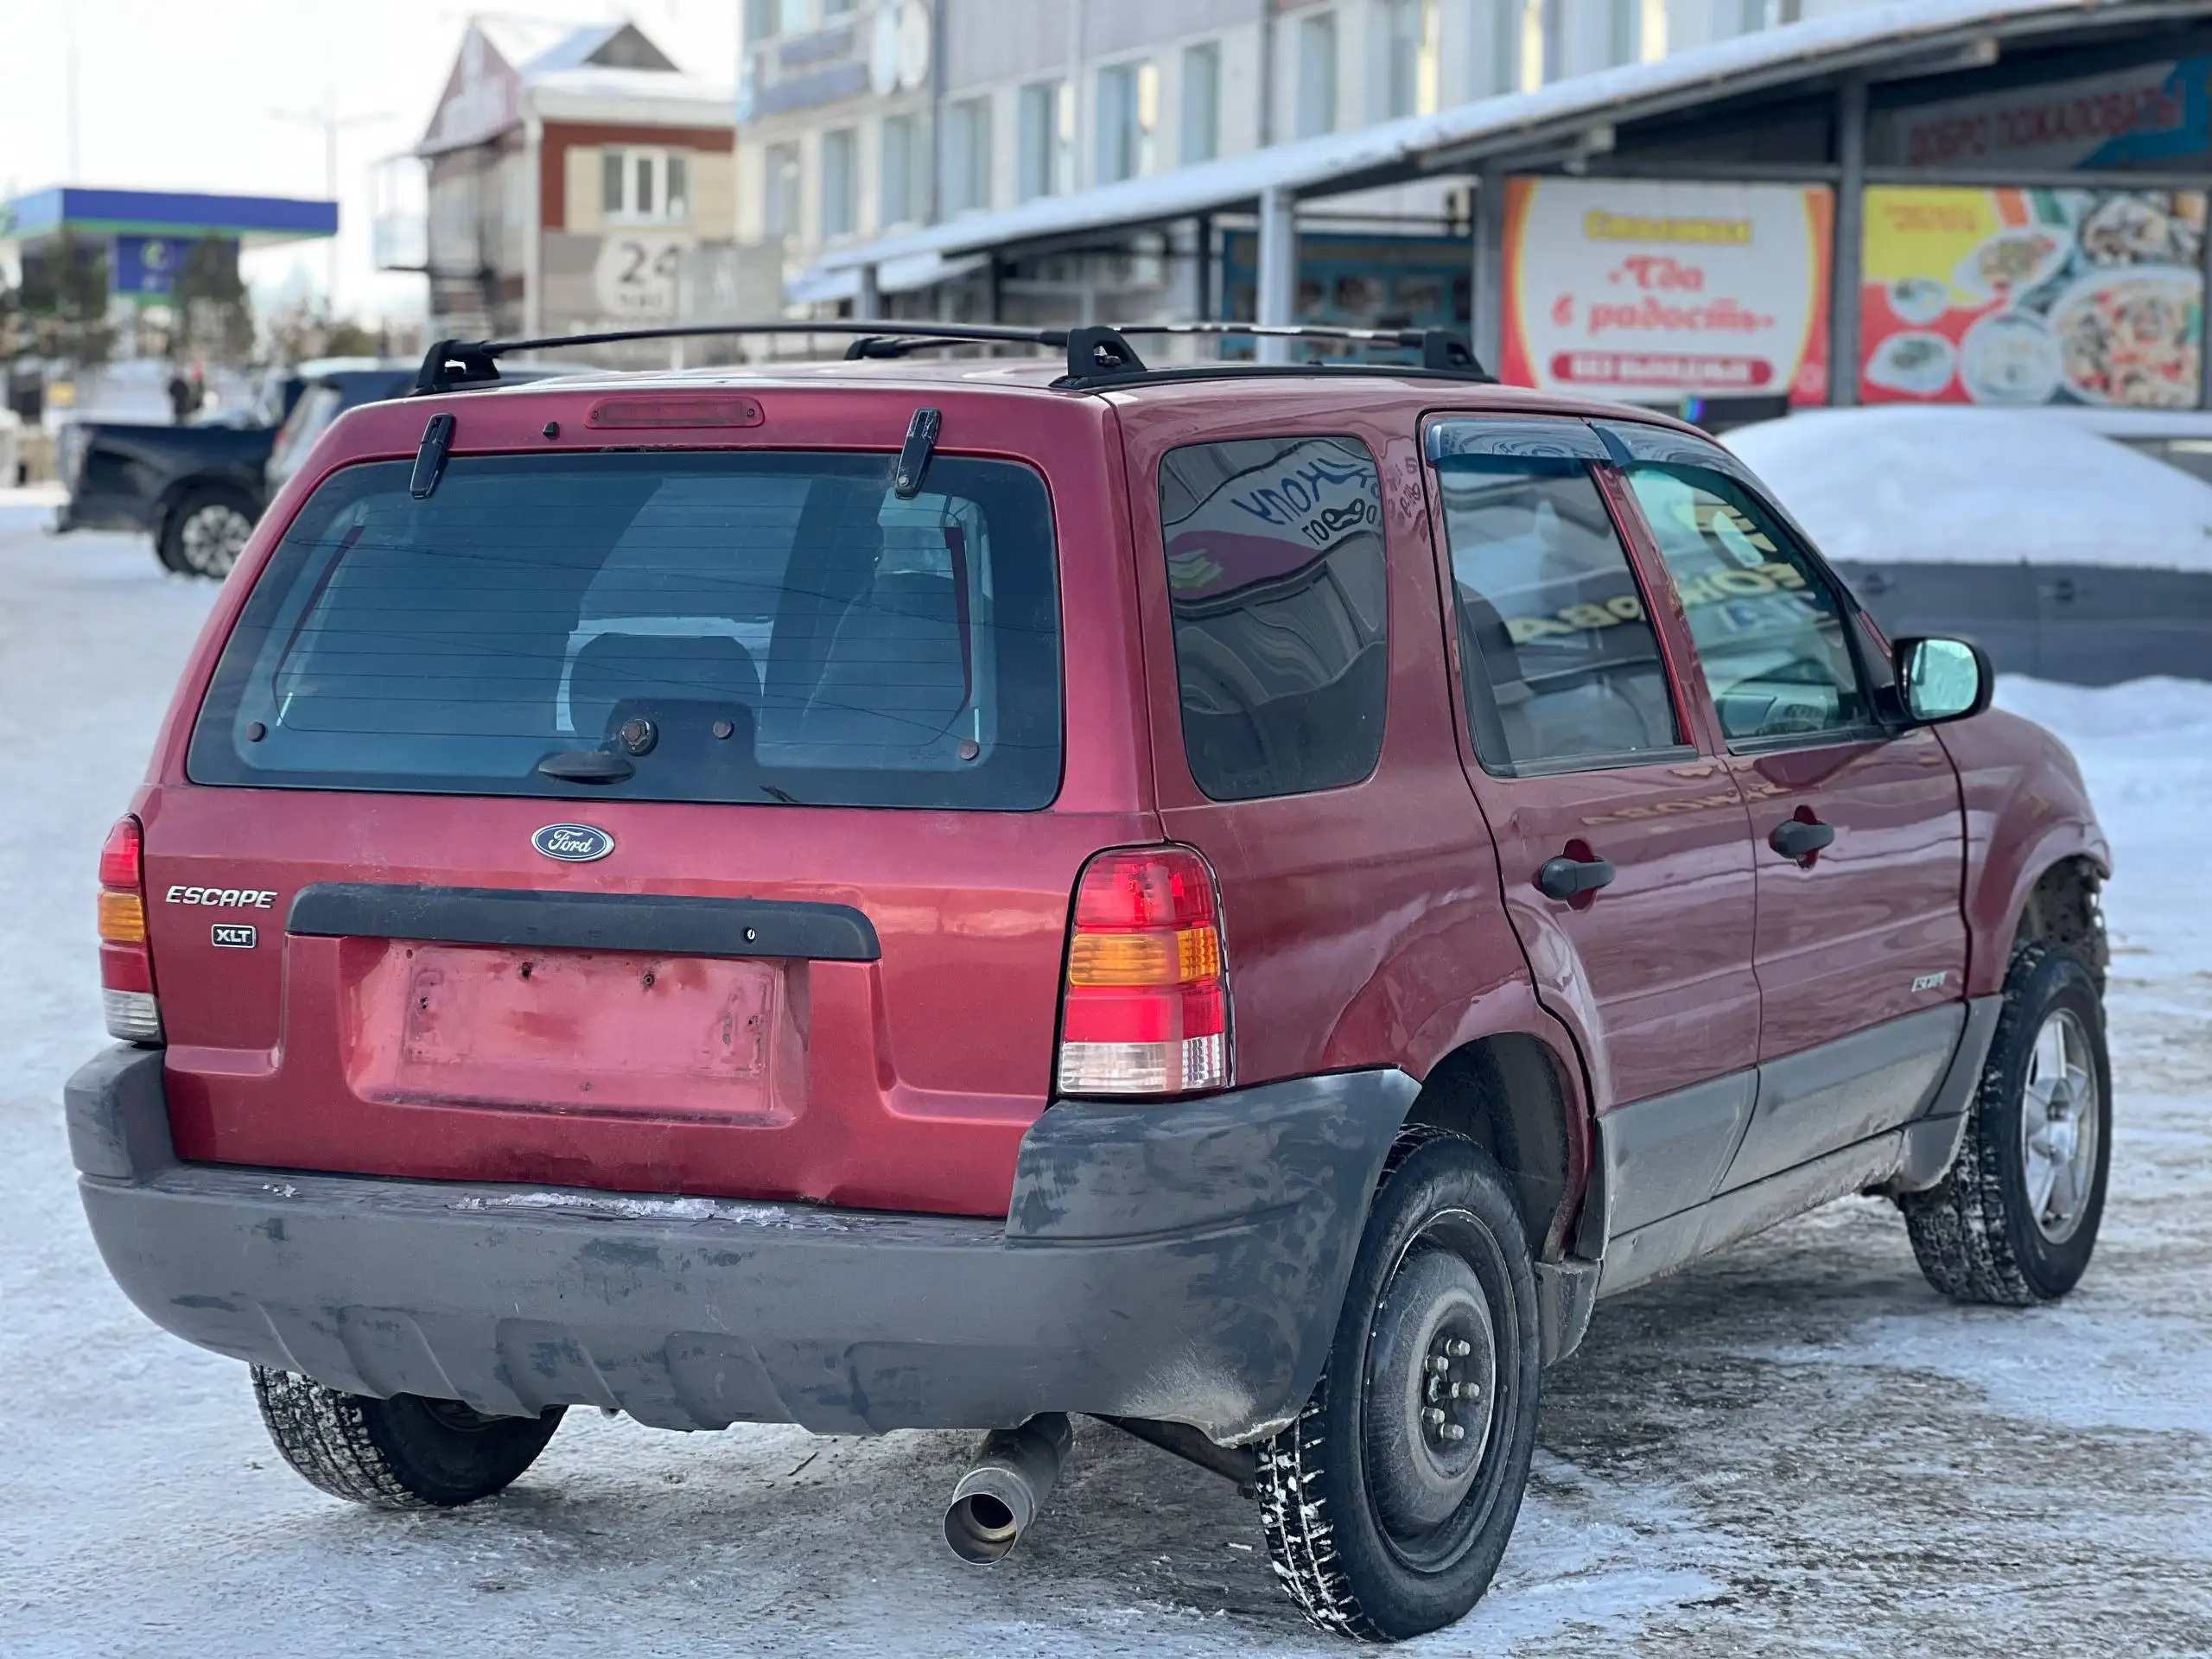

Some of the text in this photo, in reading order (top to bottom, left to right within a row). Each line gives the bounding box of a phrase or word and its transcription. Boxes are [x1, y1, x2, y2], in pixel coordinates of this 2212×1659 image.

[547, 829, 594, 853] Ford
[165, 885, 278, 909] ESCAPE
[215, 928, 251, 944] XLT
